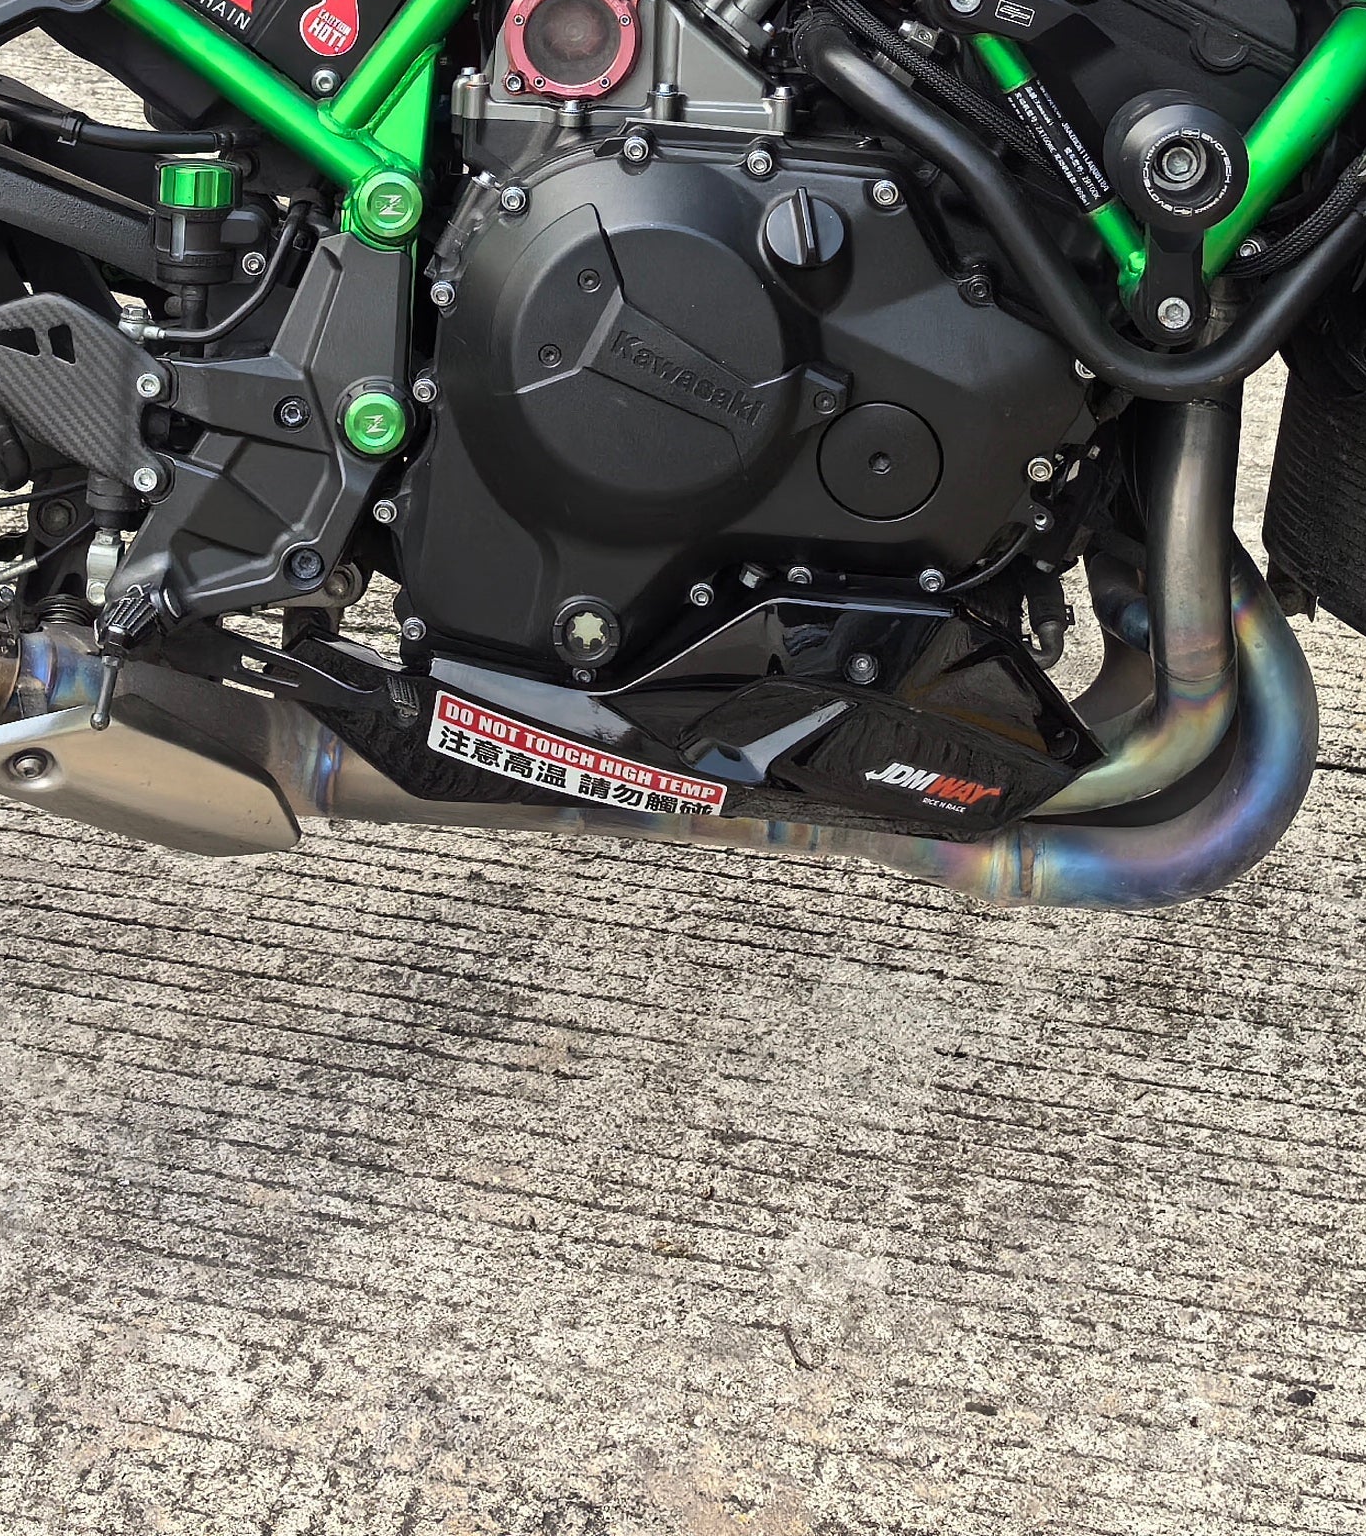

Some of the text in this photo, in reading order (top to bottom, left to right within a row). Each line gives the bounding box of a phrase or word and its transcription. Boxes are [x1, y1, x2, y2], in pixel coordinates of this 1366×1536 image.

[308, 17, 346, 52] HOT!
[318, 9, 352, 36] CAUTION
[1201, 132, 1232, 184] EVOTECH
[1142, 161, 1173, 212] EVOTECH
[611, 330, 766, 427] Kawasaki
[438, 725, 567, 788] 注意高温
[445, 701, 716, 799] DO NOT TOUCH HIGH TEMP
[864, 762, 1002, 805] JDMWAY
